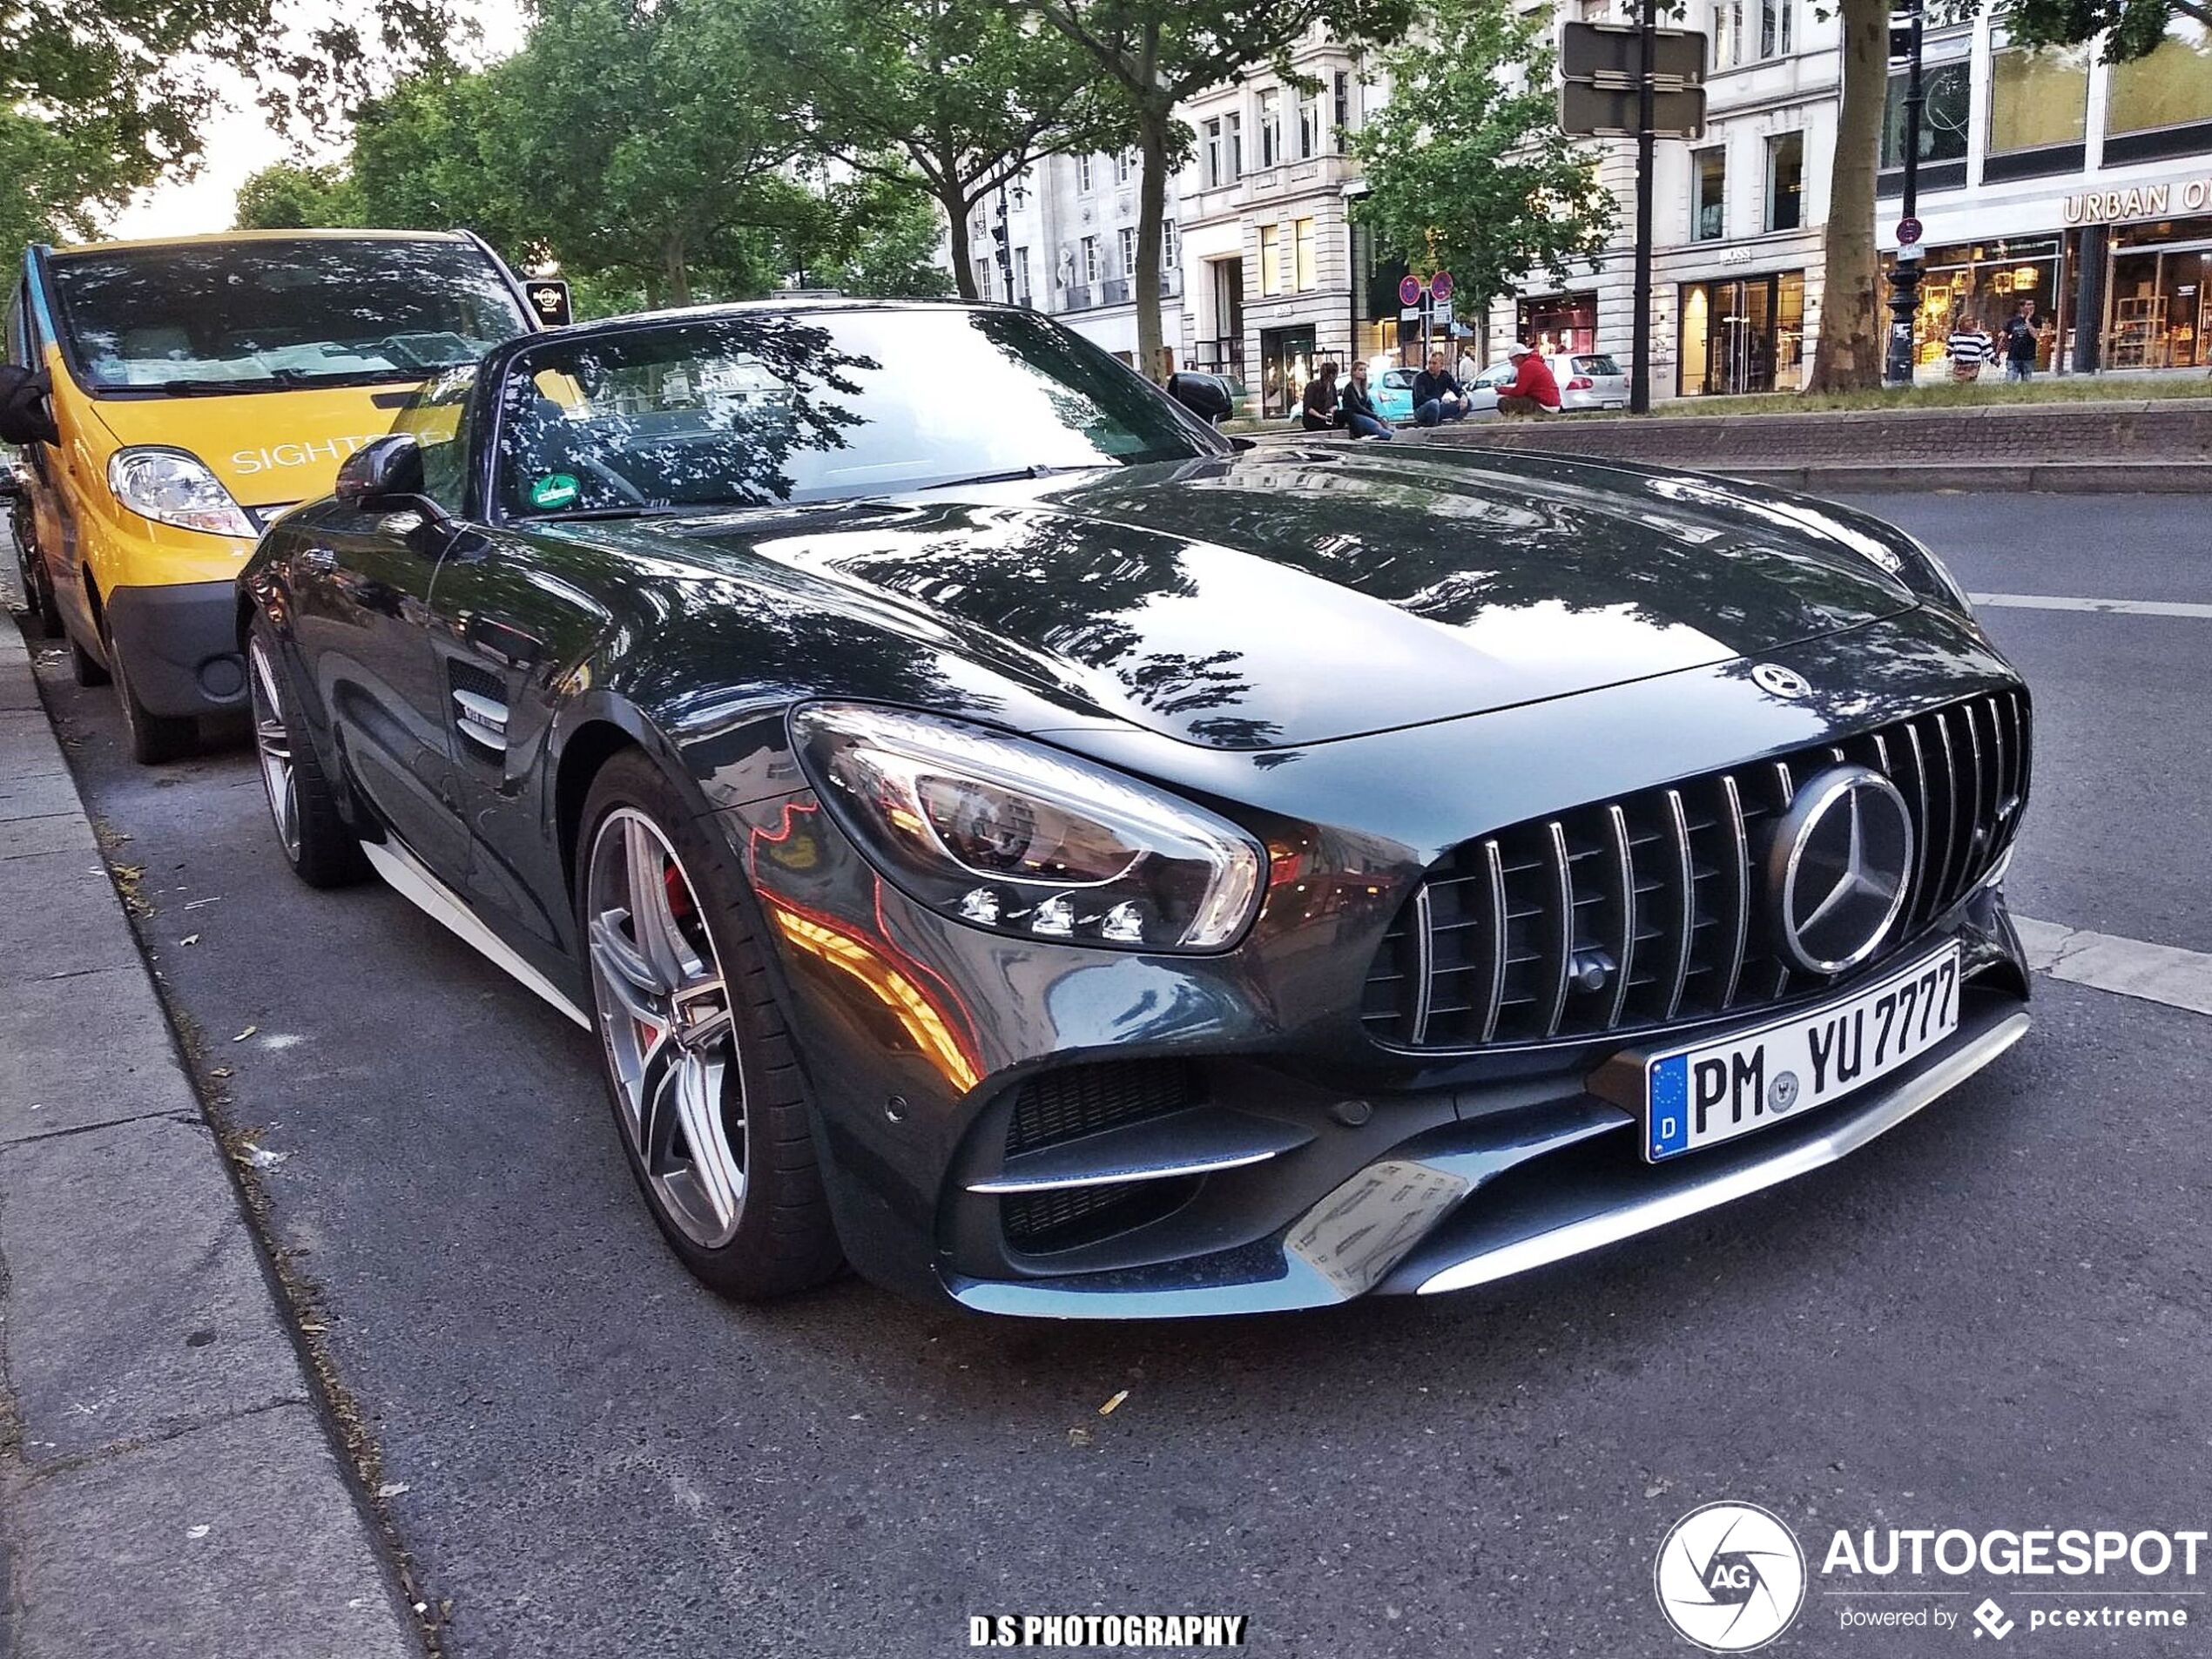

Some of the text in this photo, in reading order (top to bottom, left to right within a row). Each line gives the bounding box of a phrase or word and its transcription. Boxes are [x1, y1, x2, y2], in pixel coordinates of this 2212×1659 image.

[2064, 179, 2212, 223] URBAN O
[1661, 957, 1956, 1140] D PM YU 7777
